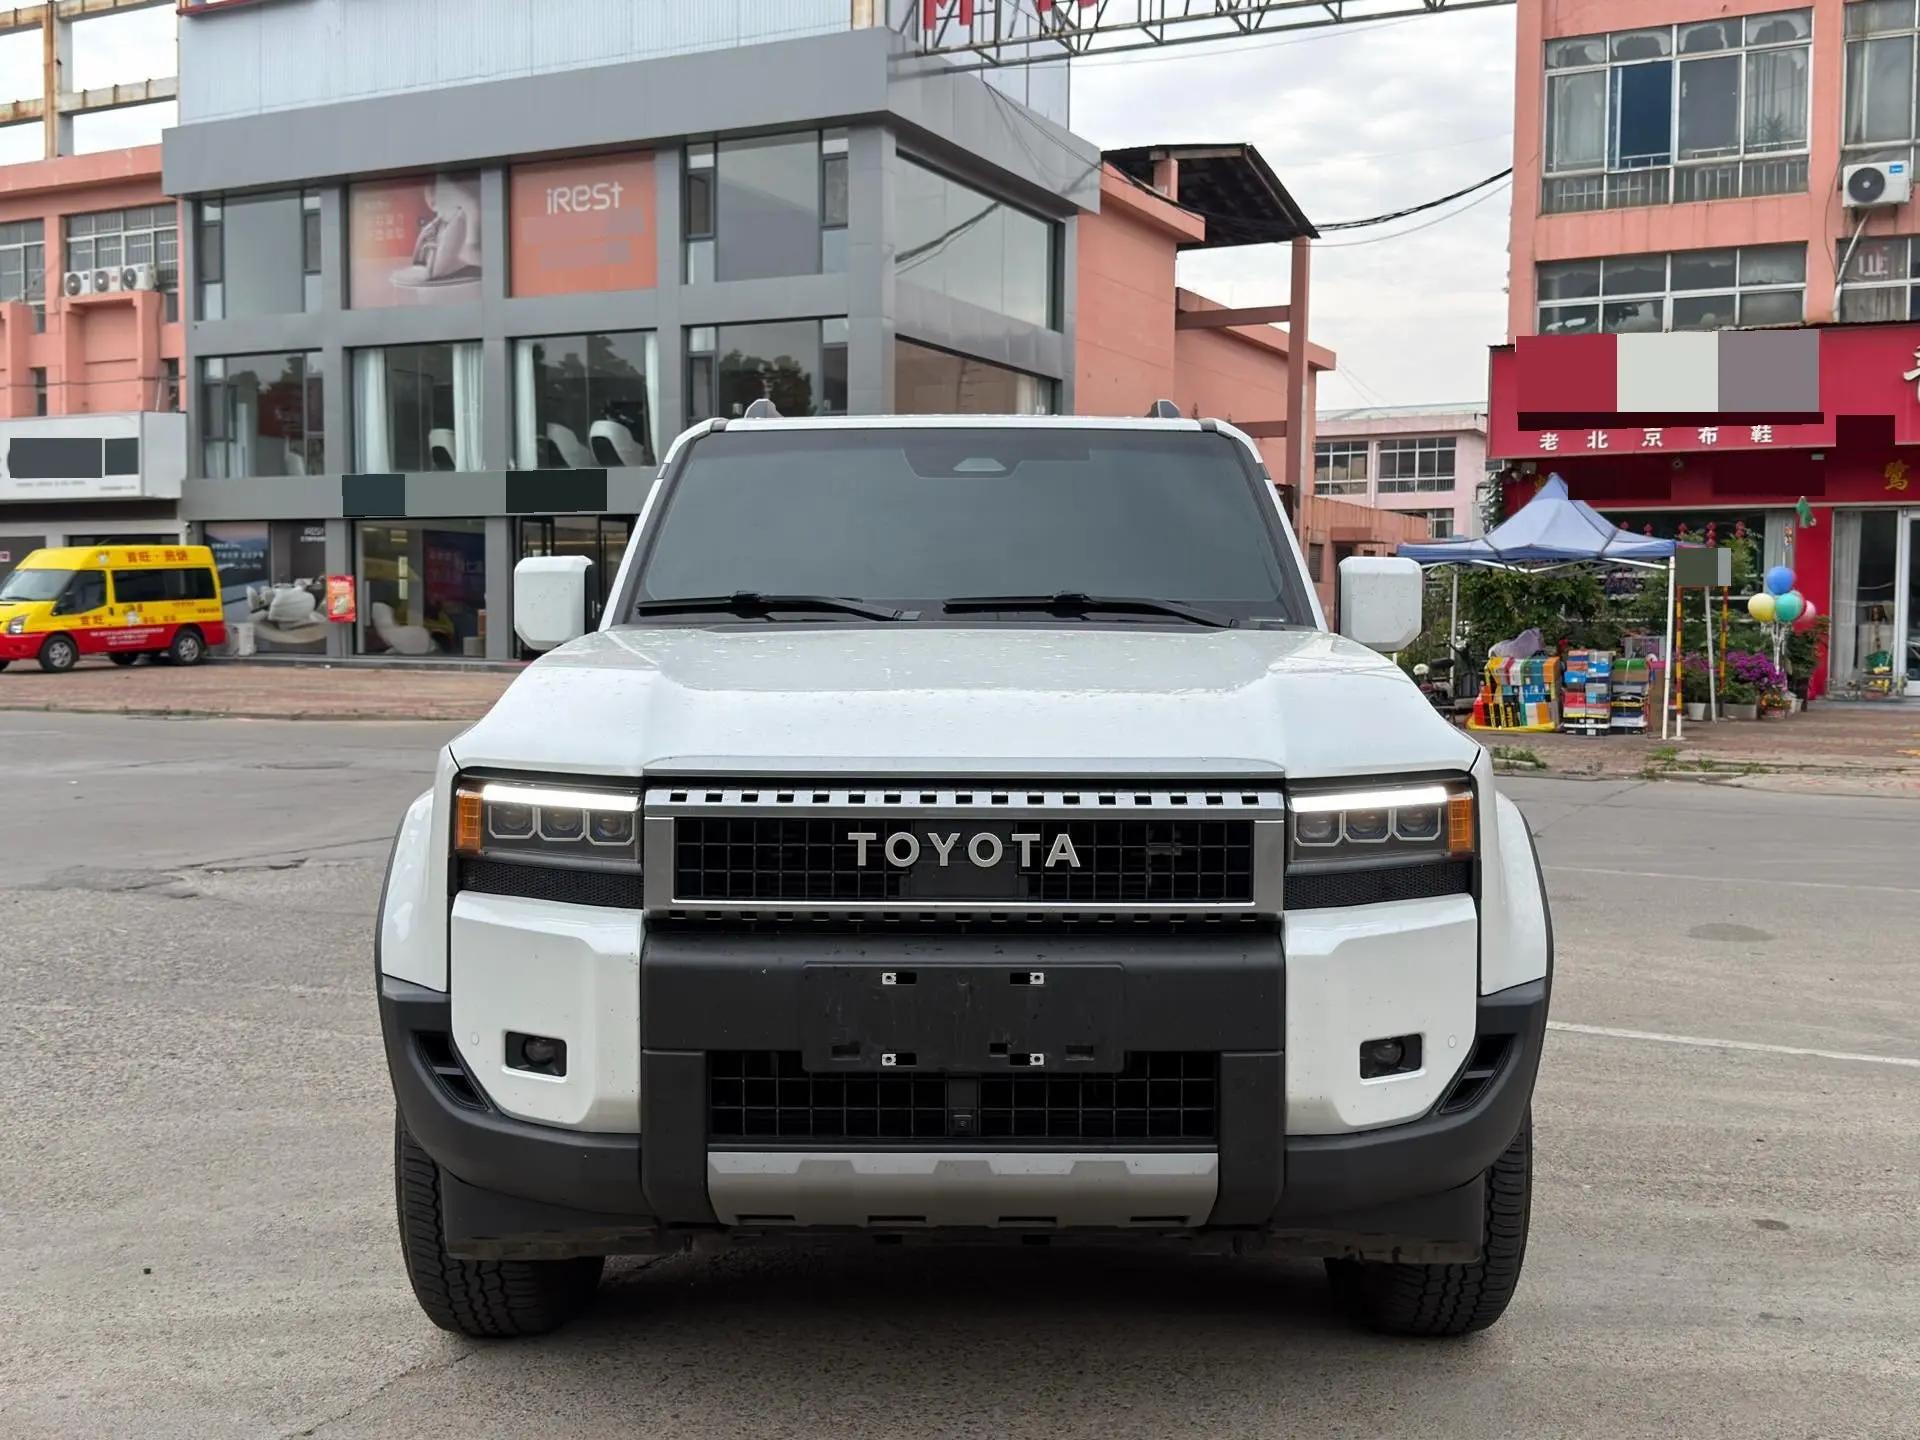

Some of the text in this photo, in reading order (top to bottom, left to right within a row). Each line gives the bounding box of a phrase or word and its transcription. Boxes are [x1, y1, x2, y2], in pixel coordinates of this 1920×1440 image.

[546, 181, 624, 215] iRest
[1539, 424, 1773, 451] 老北京布鞋
[847, 831, 1081, 868] TOYOTA
